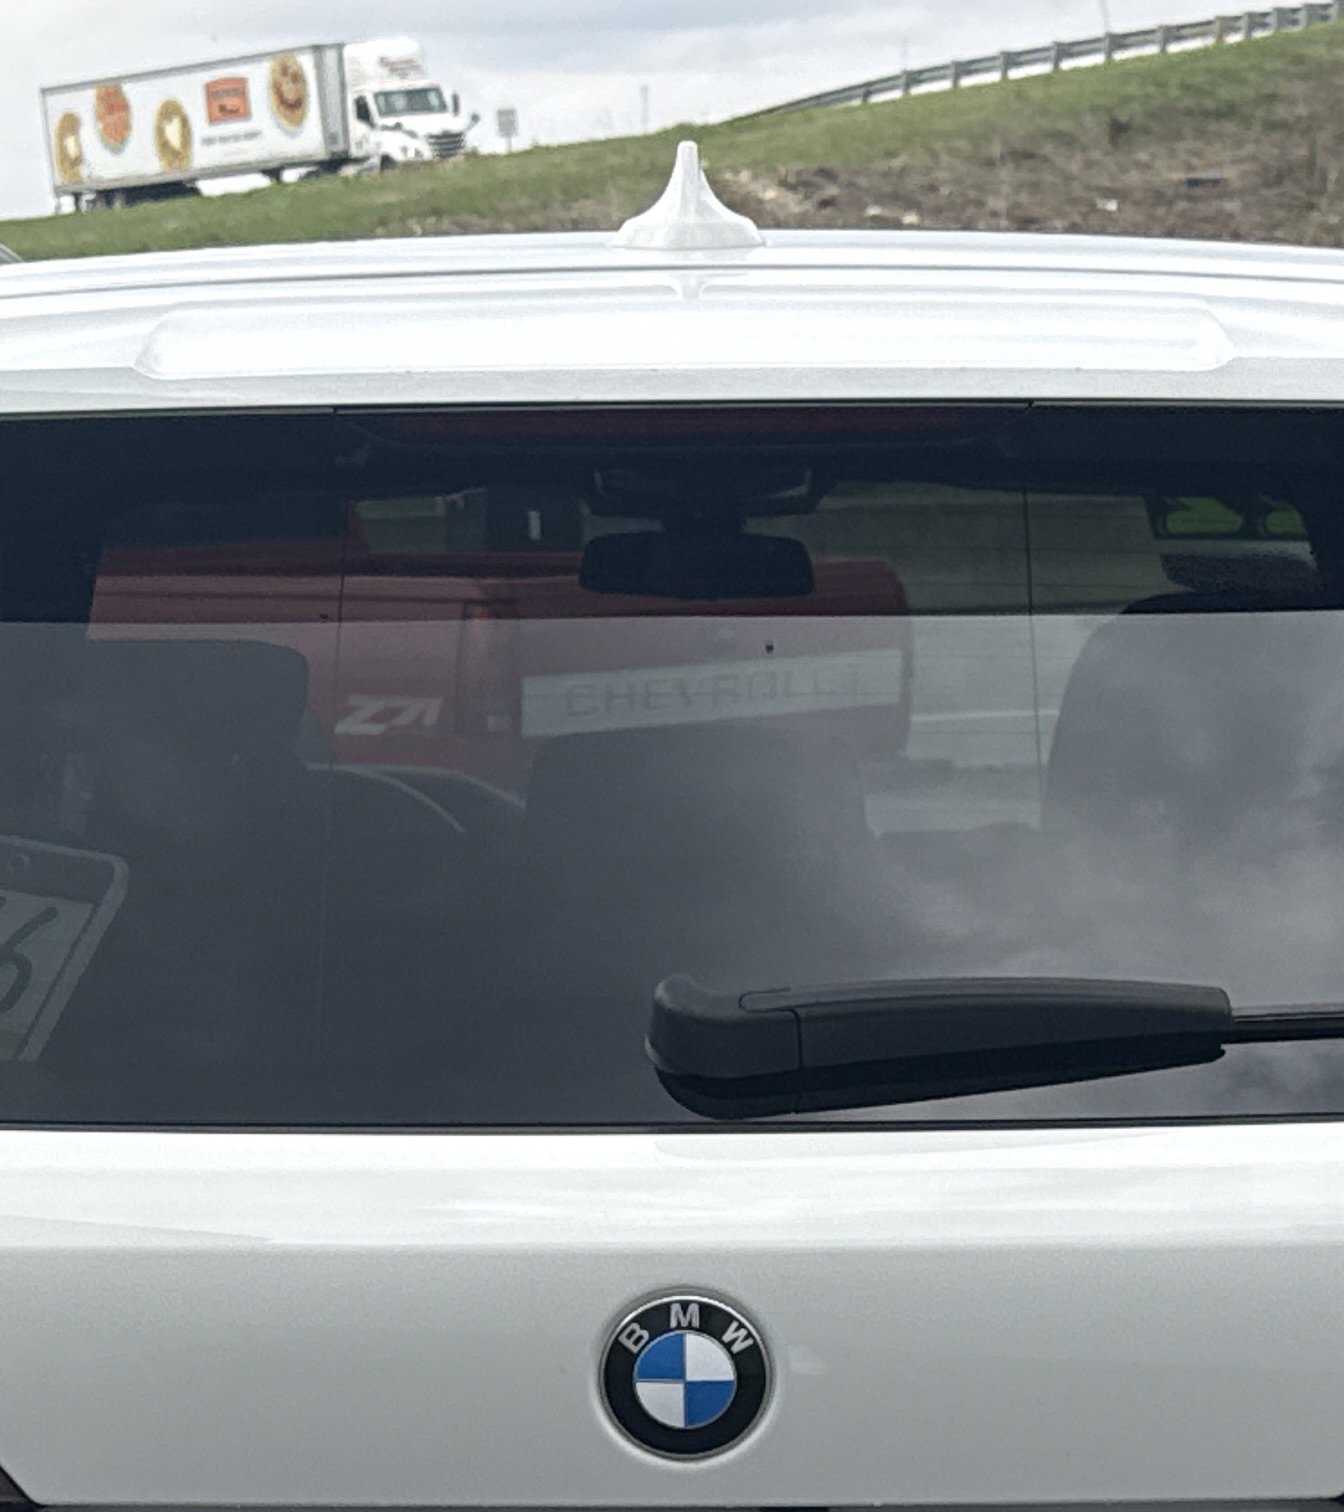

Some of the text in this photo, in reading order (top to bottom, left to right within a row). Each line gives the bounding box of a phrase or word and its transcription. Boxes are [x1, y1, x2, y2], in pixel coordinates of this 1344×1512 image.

[334, 694, 444, 736] Z71
[563, 662, 870, 718] CHEVROLET
[617, 1302, 754, 1354] BMW
